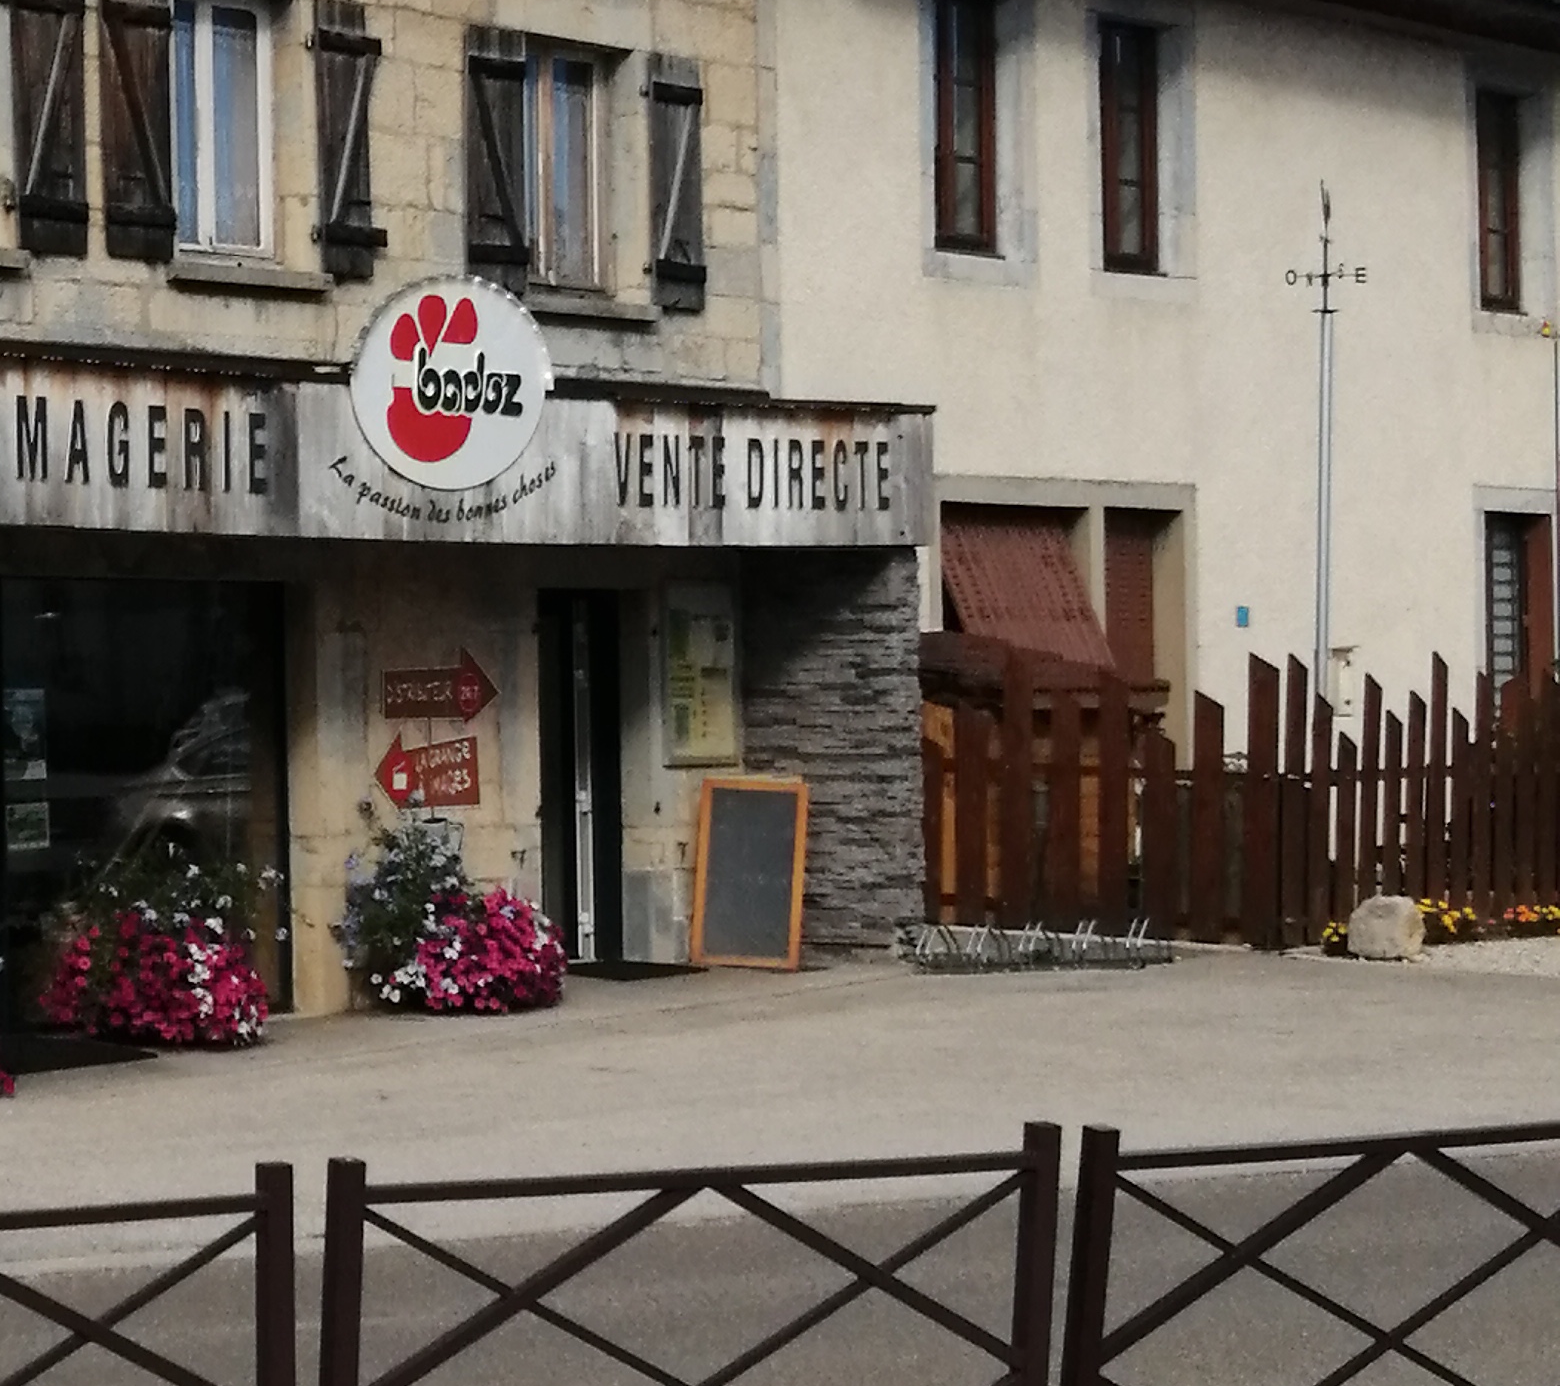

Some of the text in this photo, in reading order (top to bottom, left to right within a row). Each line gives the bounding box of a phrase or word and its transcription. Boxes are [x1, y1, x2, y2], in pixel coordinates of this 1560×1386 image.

[418, 347, 523, 416] badoz
[328, 455, 557, 523] La passion des bonnes choses
[614, 432, 890, 512] VENTE DIRECTE
